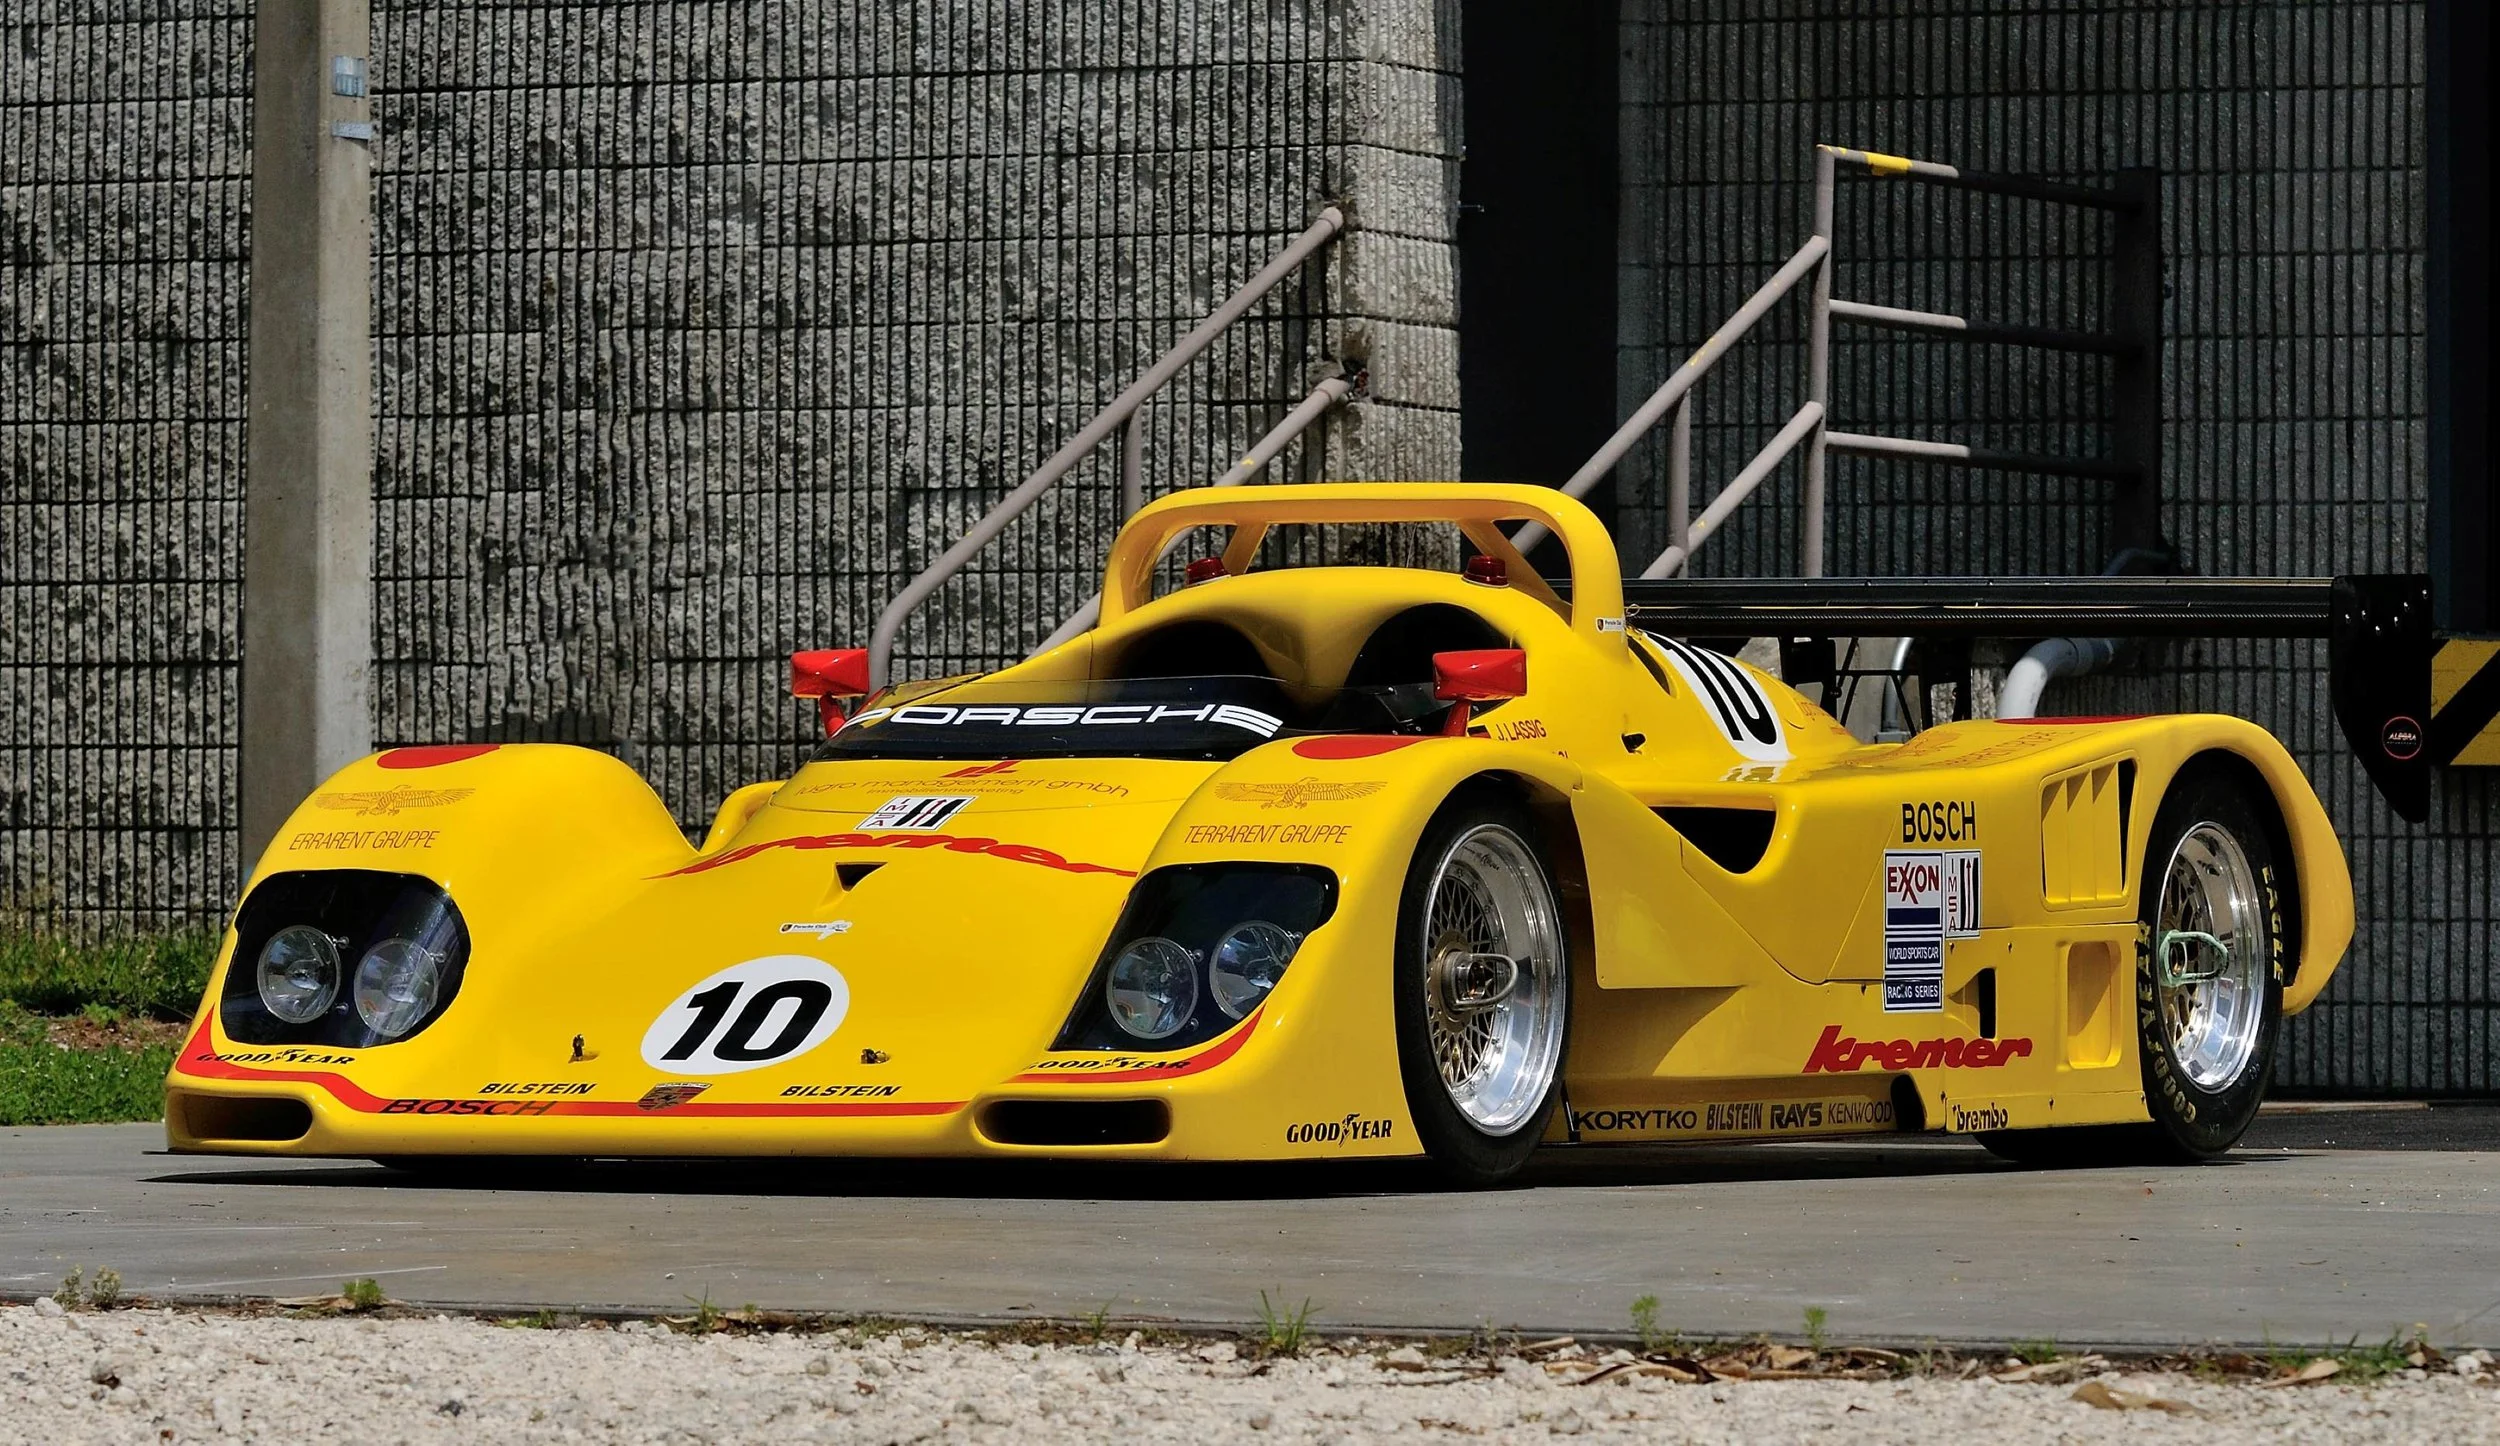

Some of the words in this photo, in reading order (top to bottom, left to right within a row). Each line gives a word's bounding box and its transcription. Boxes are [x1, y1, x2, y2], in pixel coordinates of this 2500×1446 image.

[831, 704, 1284, 738] PORSCHE
[862, 779, 1045, 787] management
[1046, 780, 1129, 797] gmbh
[1902, 801, 1976, 843] BOSCH
[372, 830, 440, 849] GRUPPE
[1184, 825, 1281, 844] TERRARENT
[1279, 825, 1352, 844] GRUPPE
[1888, 861, 1940, 904] EXXON
[1888, 947, 1908, 959] WORLD
[1907, 946, 1928, 960] SPORTS
[1928, 946, 1939, 959] CAR
[1887, 985, 1913, 998] RACNG
[1915, 984, 1939, 998] SERIES
[660, 980, 832, 1061] 10
[1802, 1025, 2033, 1073] kremer
[479, 1083, 597, 1095] BILSTEIN
[779, 1085, 902, 1097] BILSTEIN
[379, 1099, 558, 1116] BOSCH
[1574, 1108, 1698, 1131] KORYTKO
[1706, 1103, 1764, 1131] BILSTEIN
[1770, 1102, 1823, 1129] RAYS
[1828, 1101, 1892, 1125] KENWOOD
[1954, 1102, 2009, 1131] brembo
